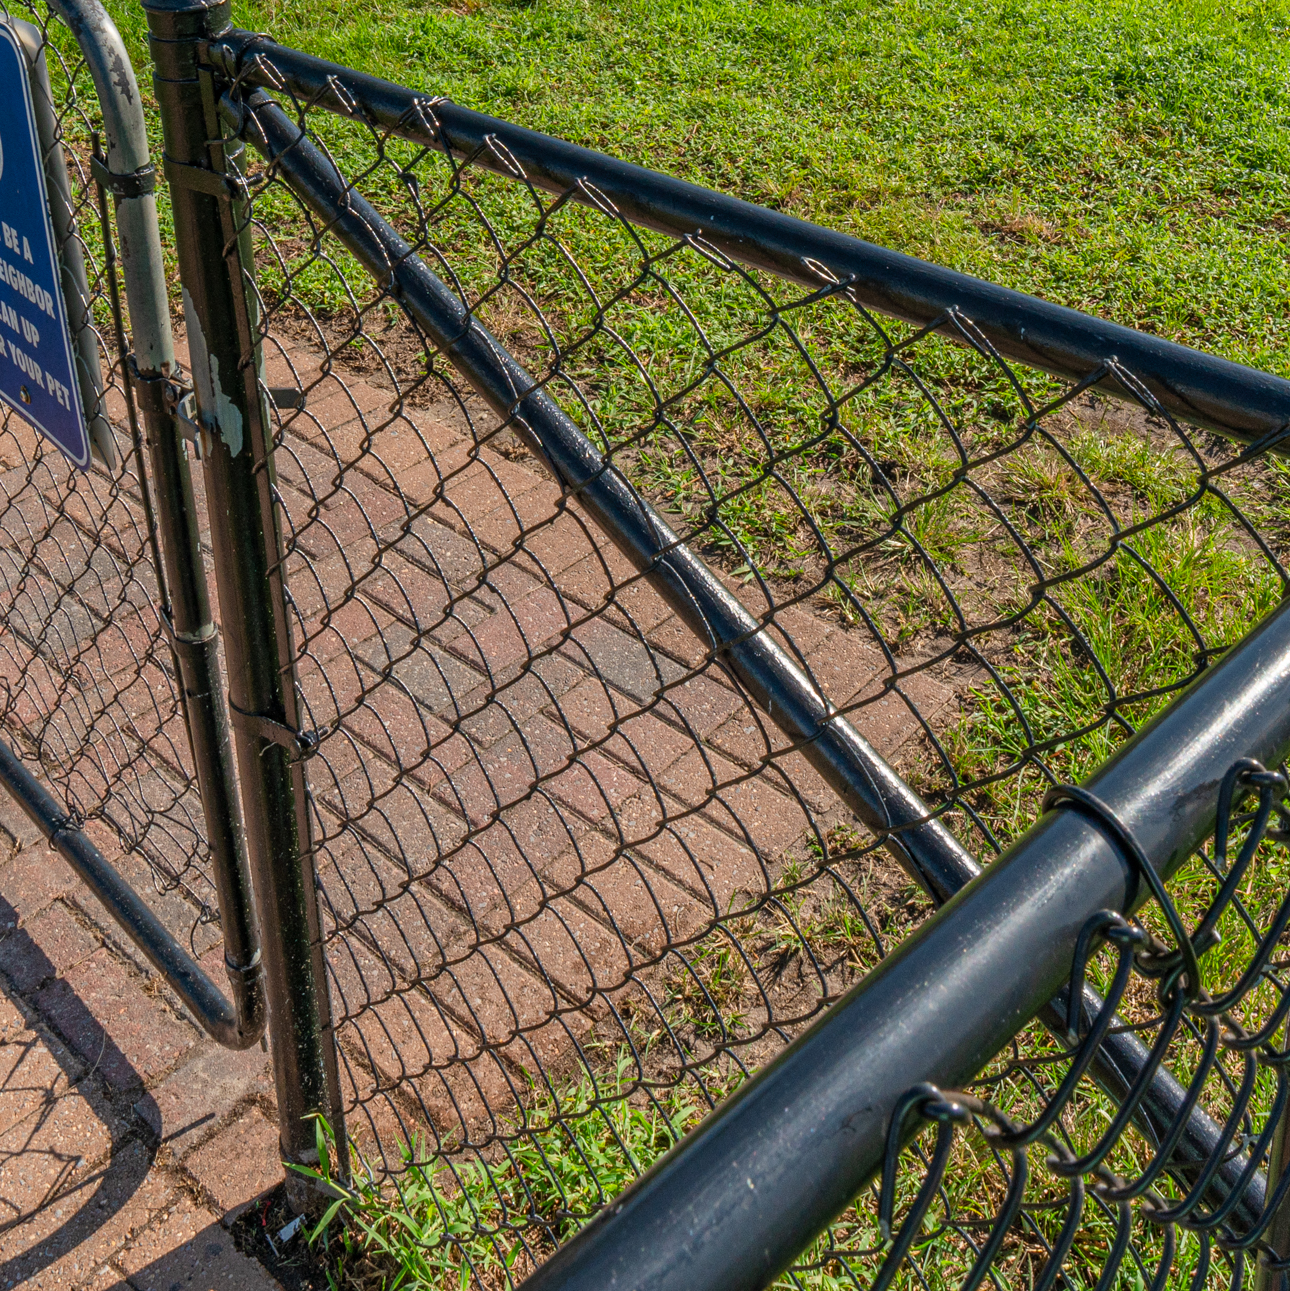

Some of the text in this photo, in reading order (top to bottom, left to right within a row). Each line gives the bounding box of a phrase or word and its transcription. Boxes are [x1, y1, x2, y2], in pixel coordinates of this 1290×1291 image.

[1, 221, 21, 255] BE
[22, 236, 34, 265] A
[20, 315, 40, 348] UP
[7, 339, 45, 390] YOUR
[45, 370, 71, 412] PET
